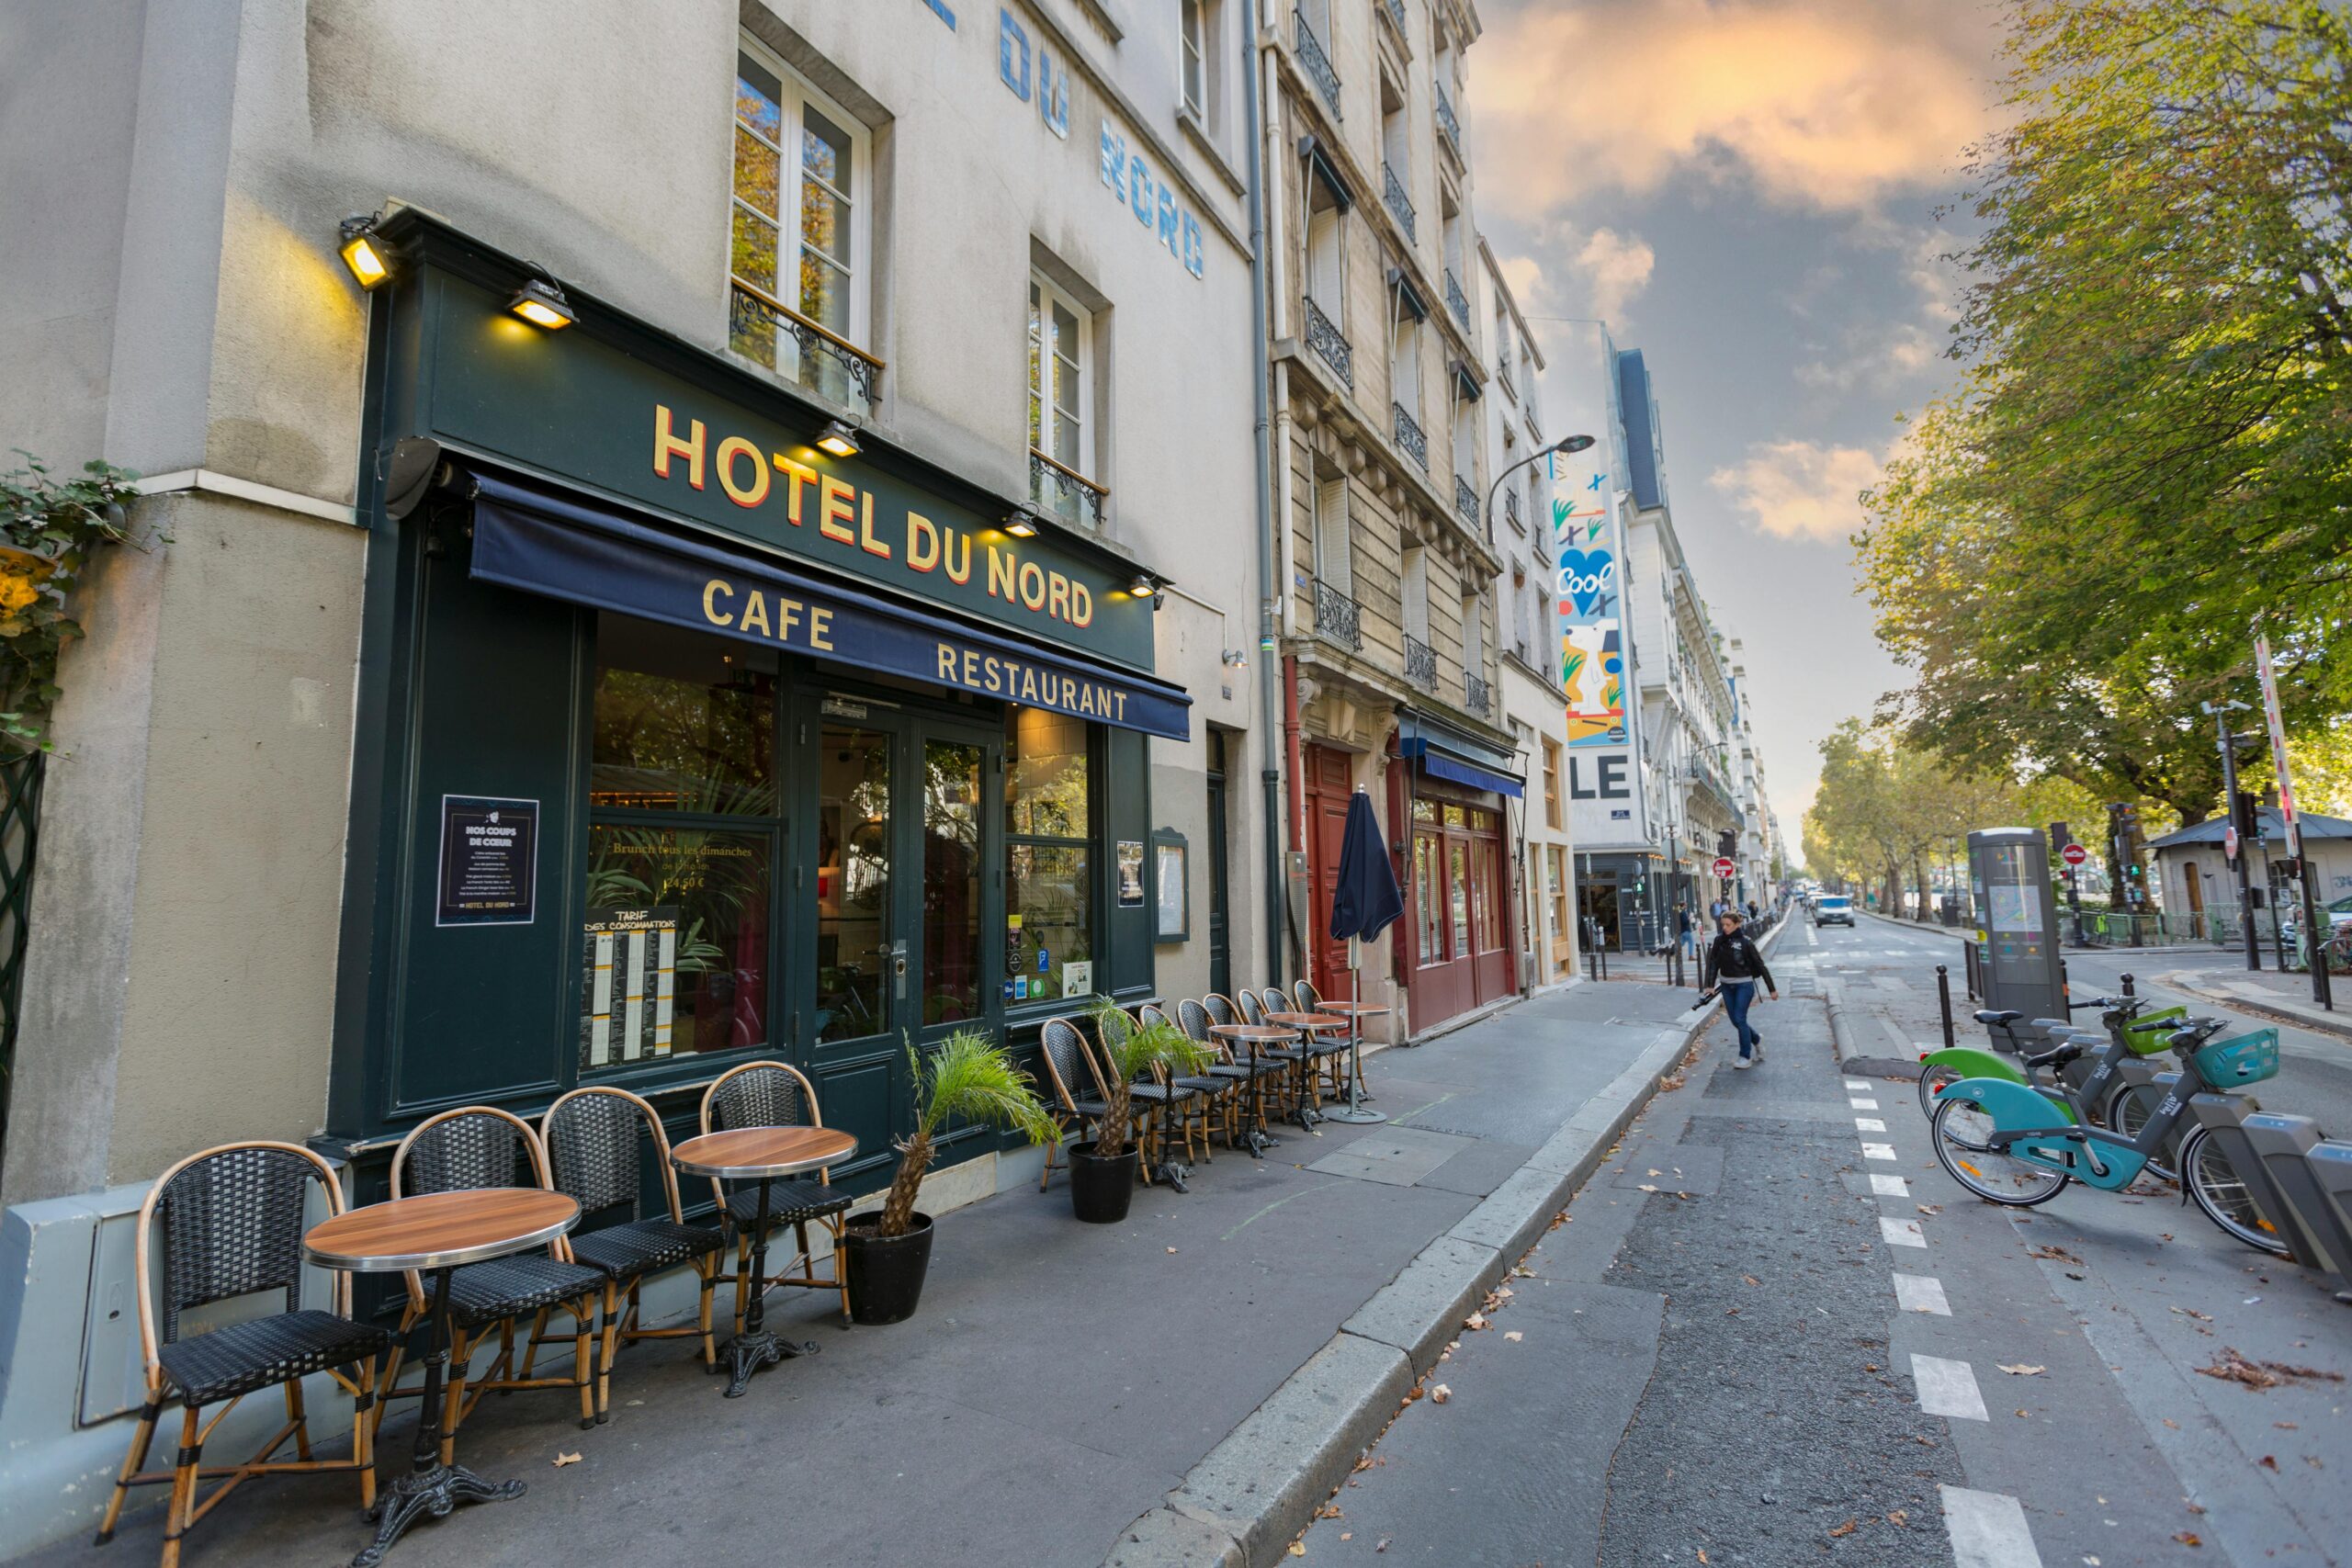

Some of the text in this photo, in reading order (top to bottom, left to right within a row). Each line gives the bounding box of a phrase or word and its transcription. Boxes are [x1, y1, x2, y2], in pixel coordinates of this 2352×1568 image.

[1000, 6, 1204, 280] DU NORD
[653, 403, 1093, 629] HOTEL DU NORD
[1556, 560, 1615, 595] Cool
[703, 578, 1128, 722] CAFE RESTAURANT
[1569, 754, 1631, 800] LE
[487, 827, 516, 836] COUPS
[469, 838, 481, 846] DE
[614, 842, 752, 857] Brunch tous les dimanches
[697, 877, 705, 887] €
[614, 910, 649, 921] TARIF
[583, 919, 676, 931] DES CONSOMMATIONS
